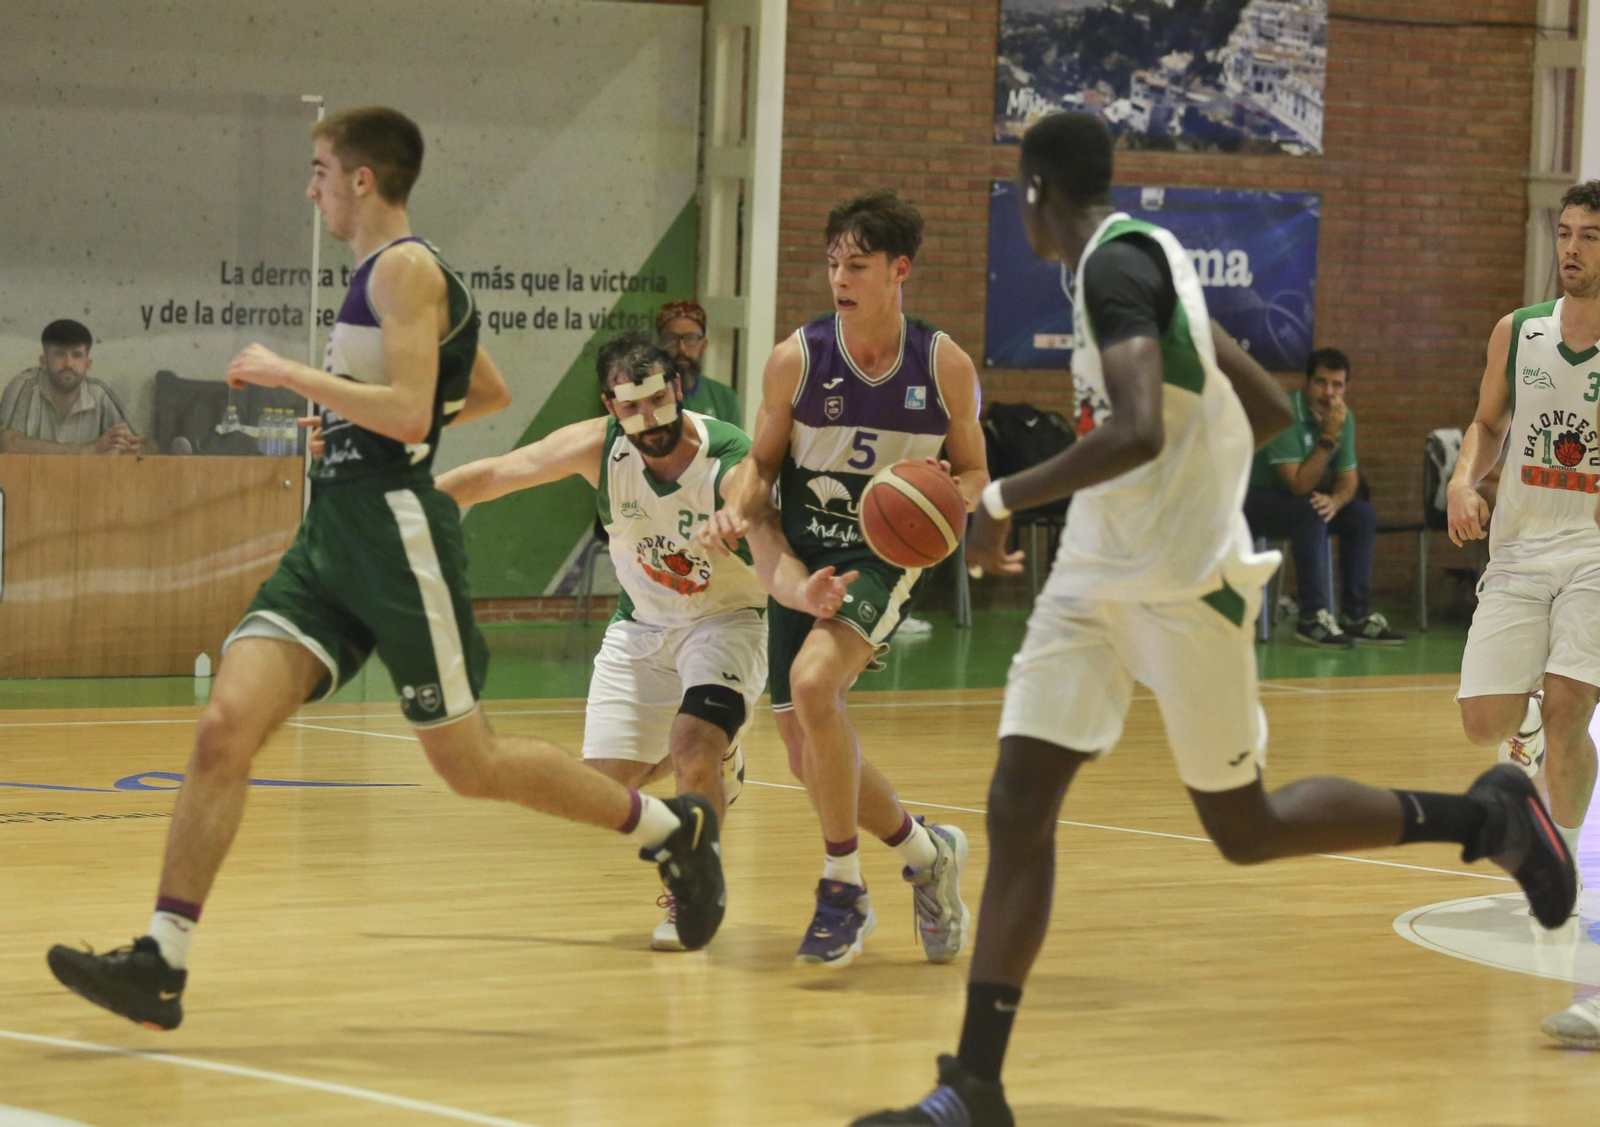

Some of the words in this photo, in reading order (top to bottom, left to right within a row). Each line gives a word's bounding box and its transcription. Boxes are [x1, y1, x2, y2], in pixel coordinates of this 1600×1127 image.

[221, 261, 244, 285] La
[471, 265, 514, 290] más
[521, 271, 560, 297] que
[566, 268, 584, 291] la
[590, 269, 667, 293] victoria
[1185, 248, 1253, 288] ma
[141, 304, 153, 330] y
[160, 300, 188, 325] de
[195, 300, 214, 325] la
[221, 302, 303, 327] derrota
[488, 310, 527, 334] que
[533, 306, 559, 329] de
[565, 307, 582, 329] la
[588, 306, 657, 331] victori
[847, 431, 878, 470] 5
[804, 516, 864, 543] Andalu
